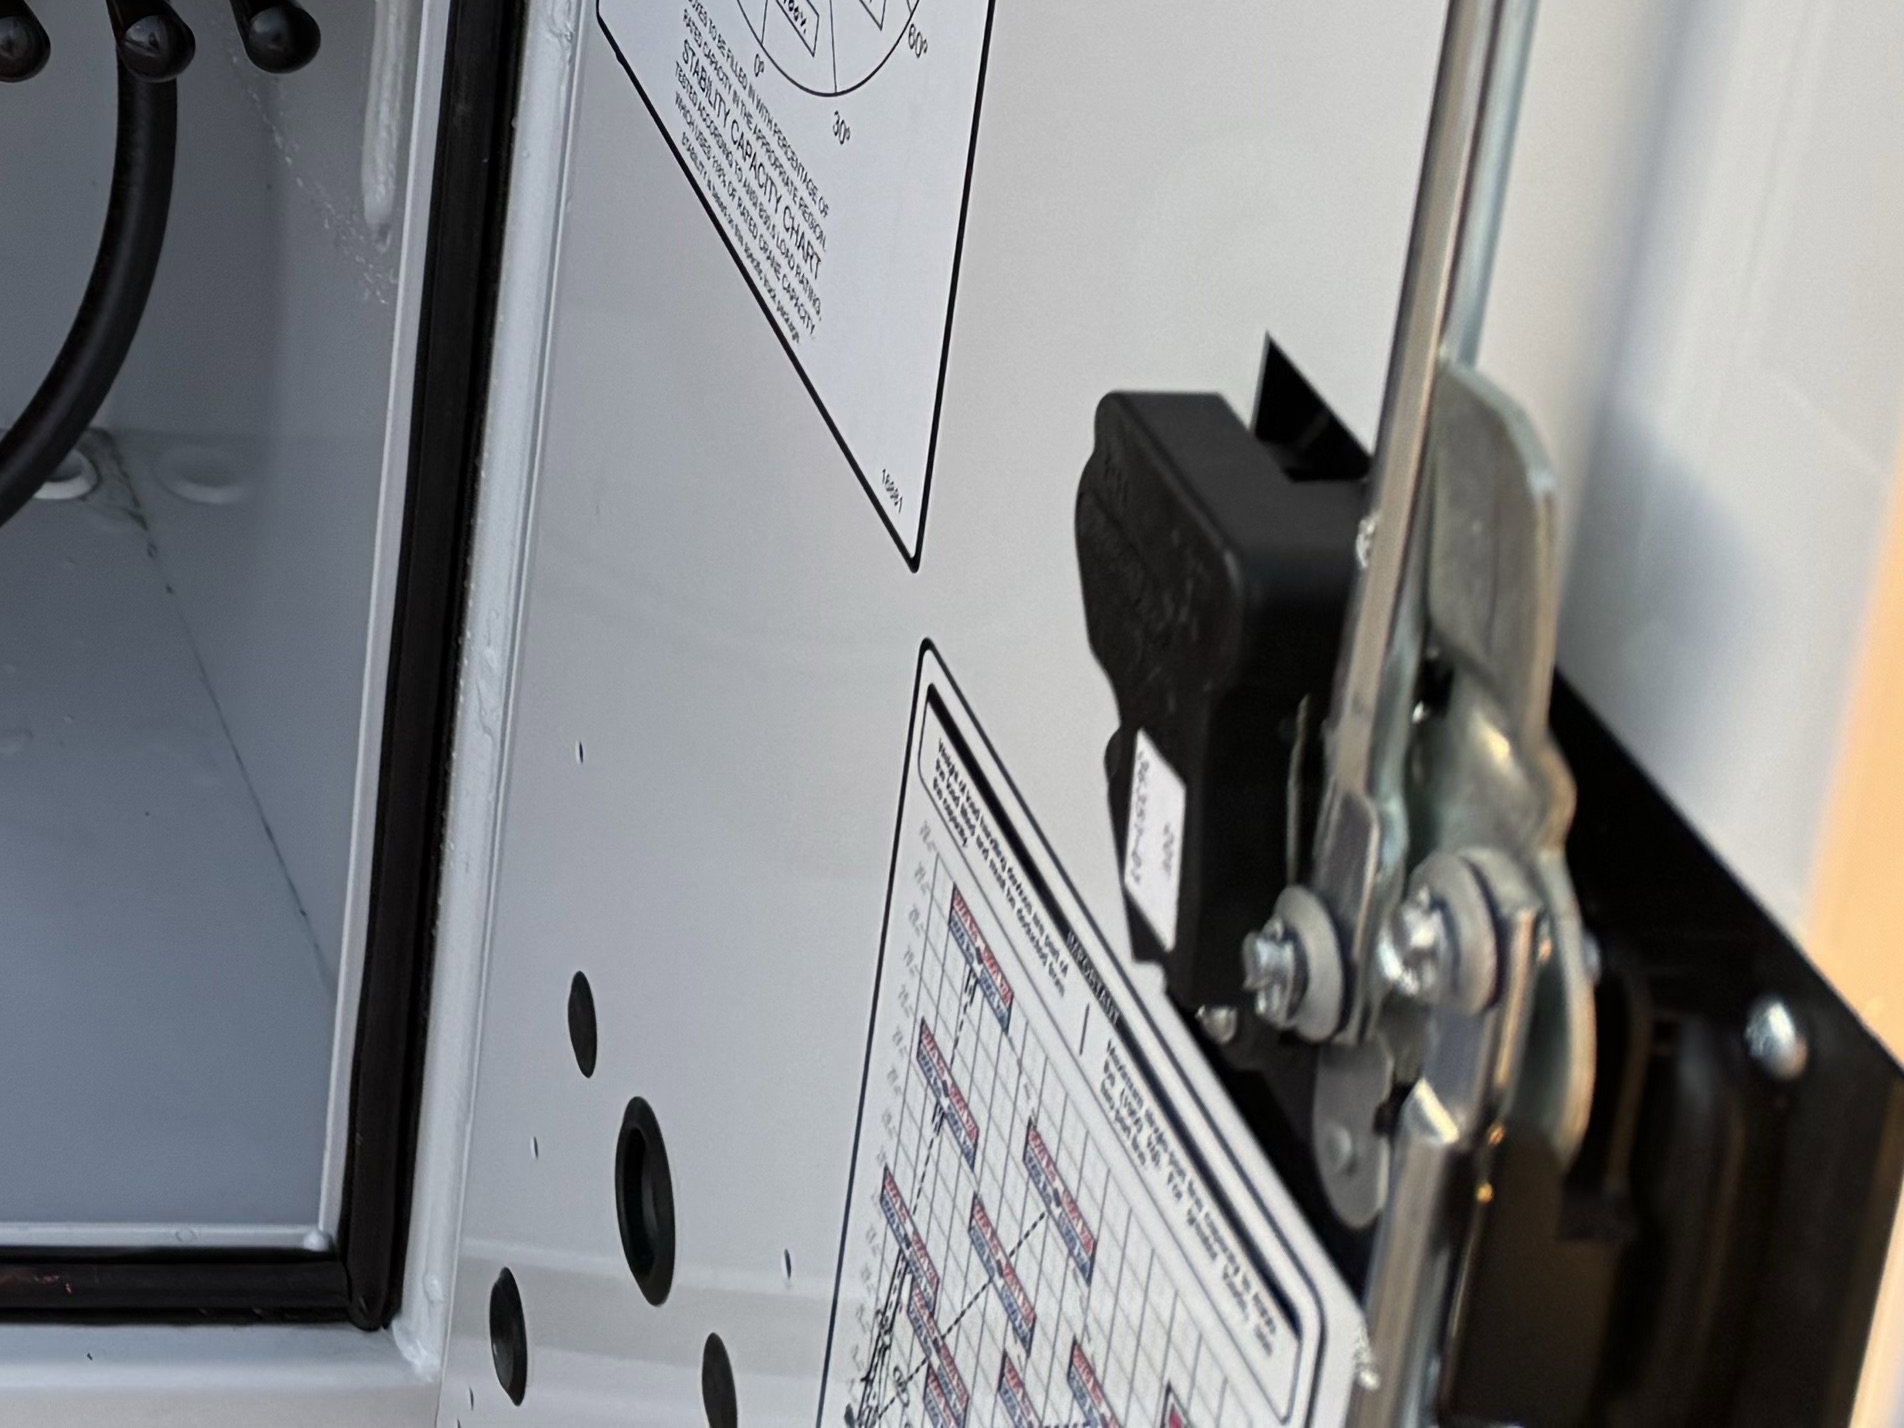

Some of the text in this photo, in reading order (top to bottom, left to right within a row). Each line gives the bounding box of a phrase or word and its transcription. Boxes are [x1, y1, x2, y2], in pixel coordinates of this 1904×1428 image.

[682, 38, 731, 129] STABILITY
[730, 120, 780, 215] CAPACITY
[782, 205, 822, 280] CHART
